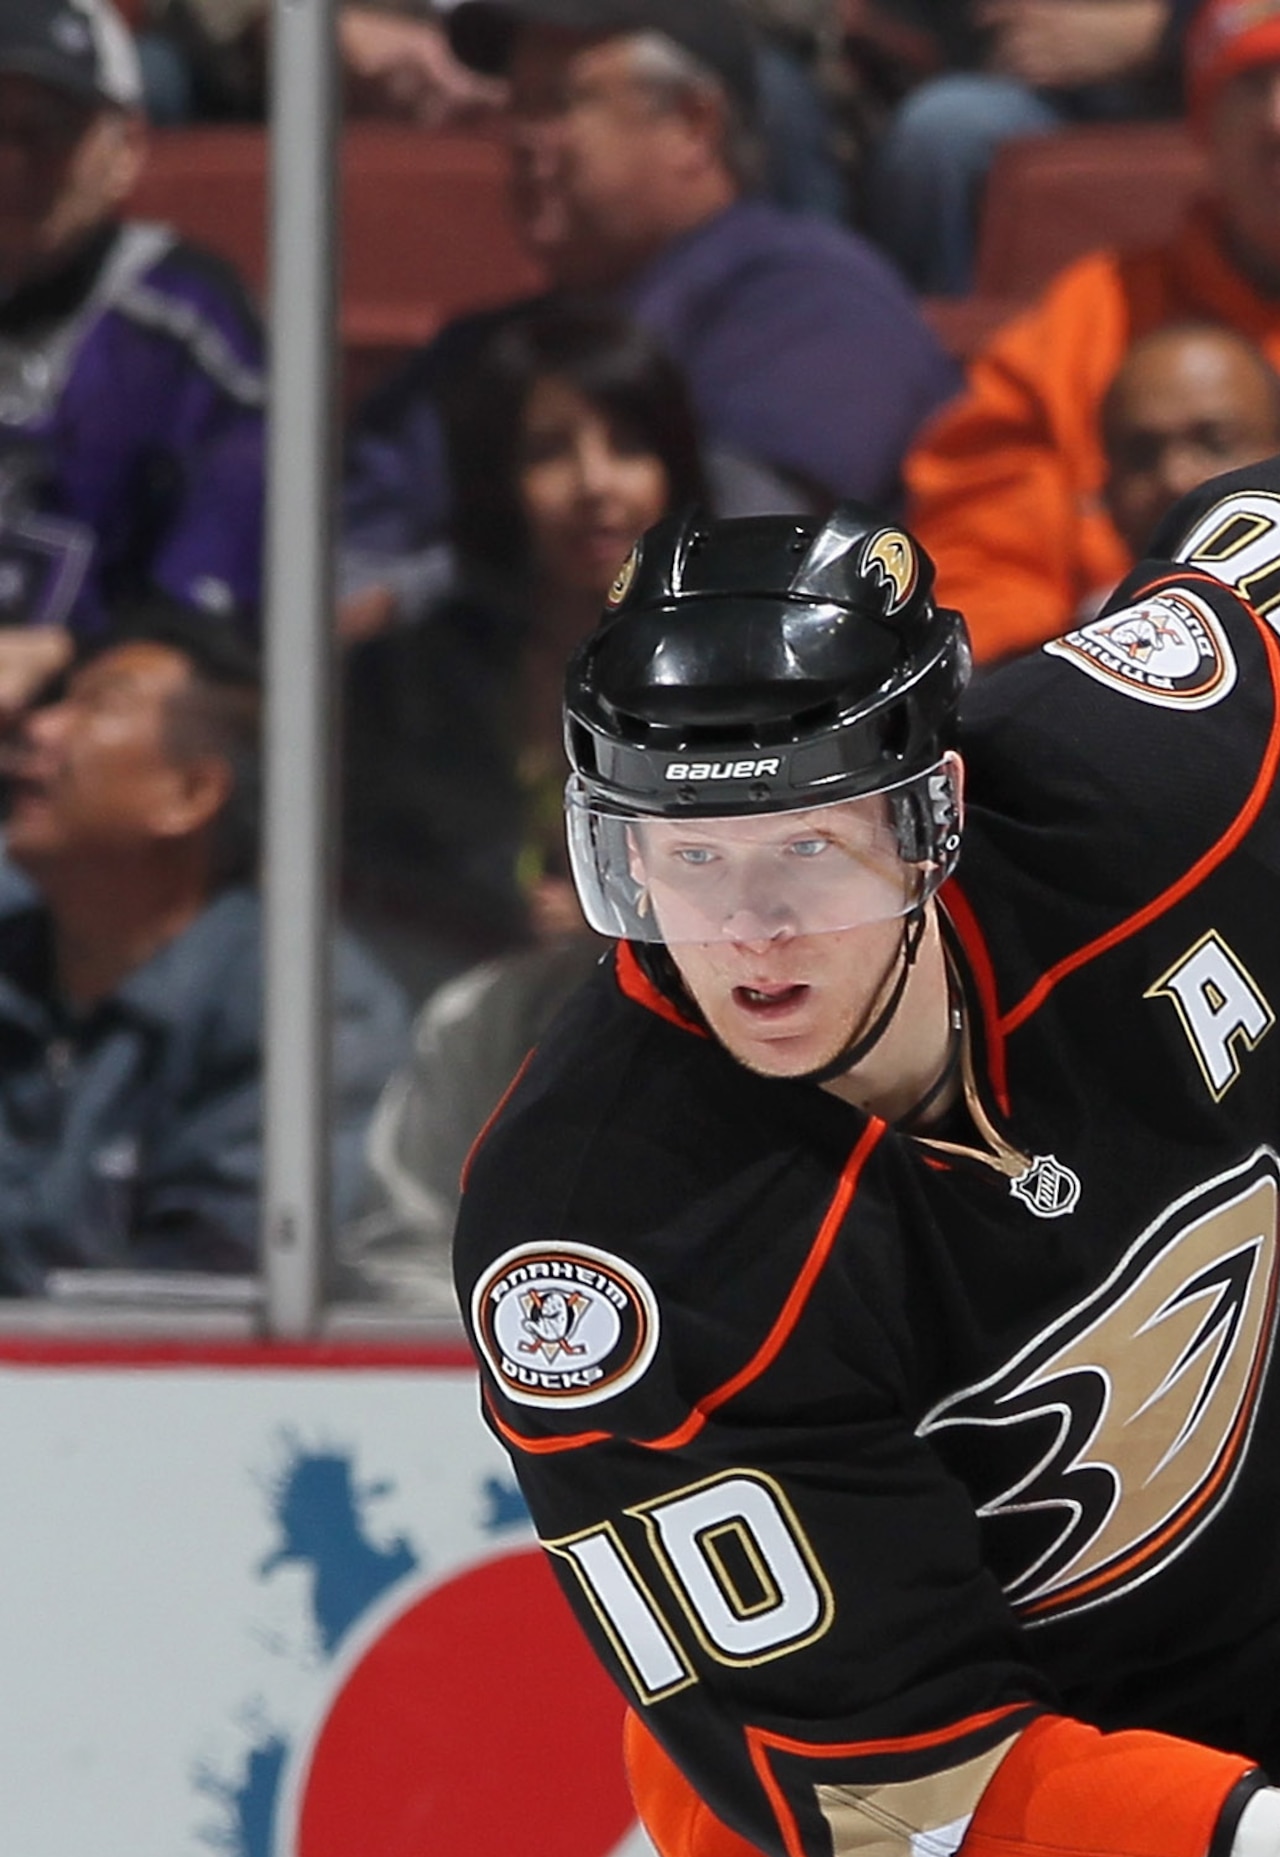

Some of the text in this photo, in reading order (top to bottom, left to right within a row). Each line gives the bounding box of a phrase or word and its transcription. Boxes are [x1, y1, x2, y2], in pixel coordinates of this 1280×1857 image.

[665, 758, 780, 781] BAUER
[1142, 927, 1277, 1103] A
[490, 1261, 628, 1310] ANAHEIM
[502, 1355, 604, 1388] DUCKS
[540, 1467, 835, 1706] 10
